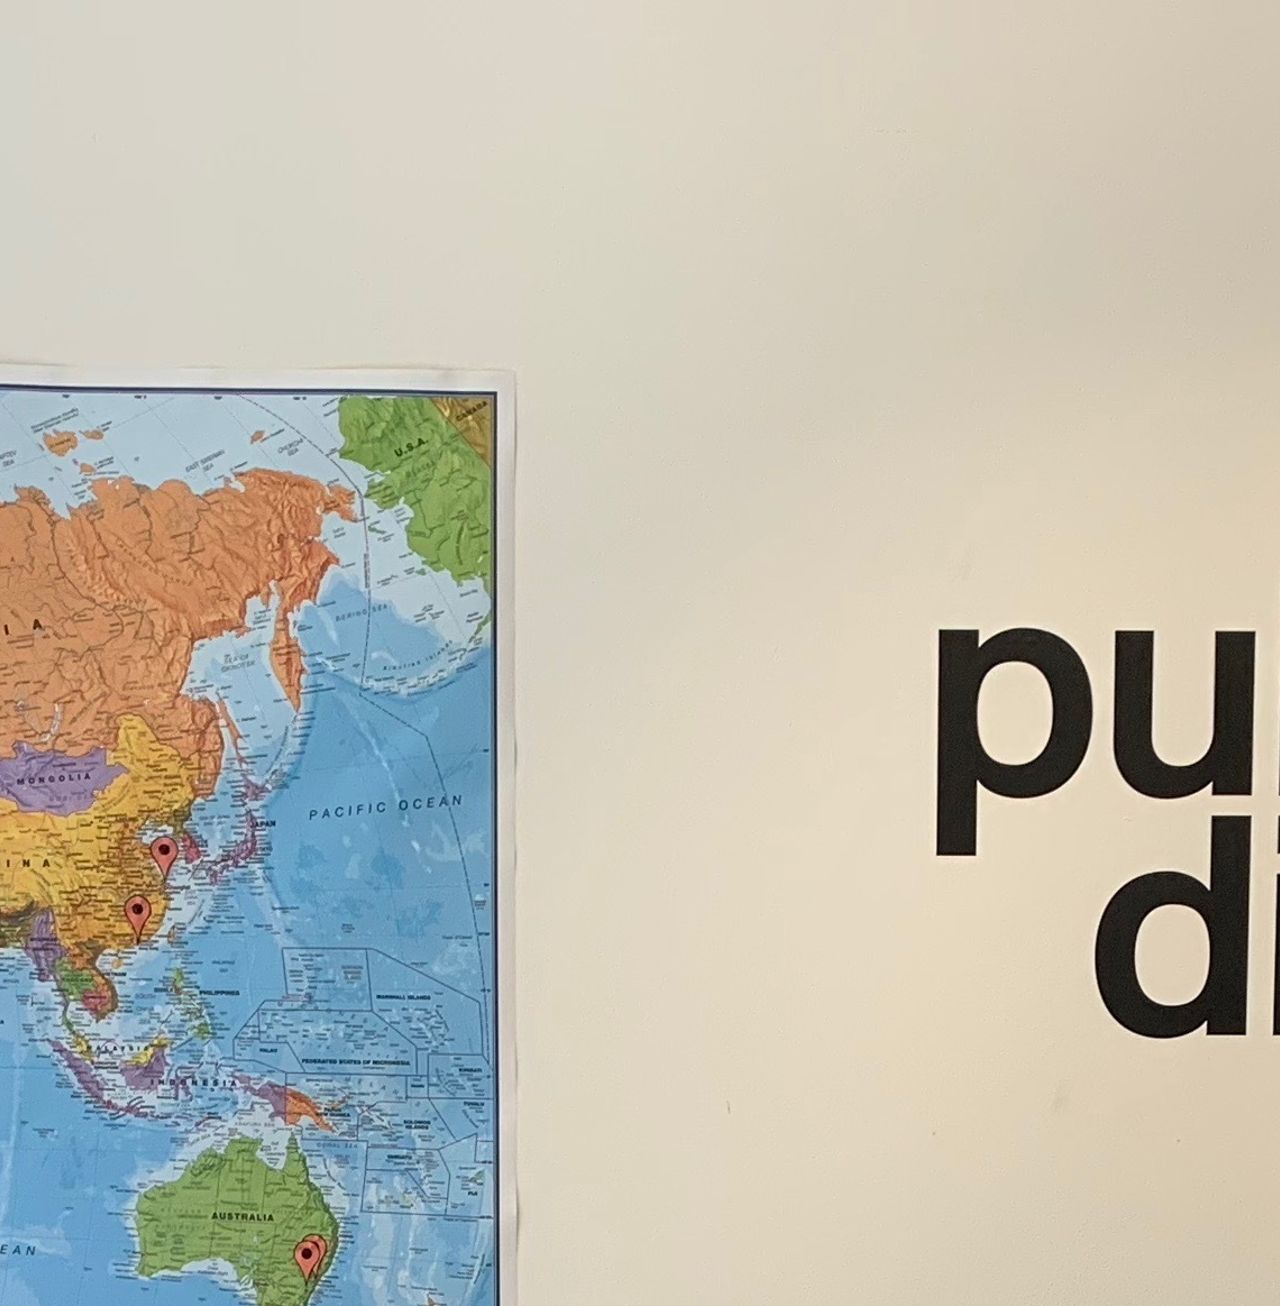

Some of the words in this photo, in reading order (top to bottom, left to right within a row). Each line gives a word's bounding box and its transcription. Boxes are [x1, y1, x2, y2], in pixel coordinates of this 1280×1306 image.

[394, 438, 429, 458] U.S.A.
[17, 772, 92, 786] MONGOLIA
[309, 802, 387, 821] PACIFIC
[399, 795, 463, 811] OCEAN
[151, 1079, 237, 1087] INDONESIA
[211, 1212, 275, 1222] AUSTRALIA
